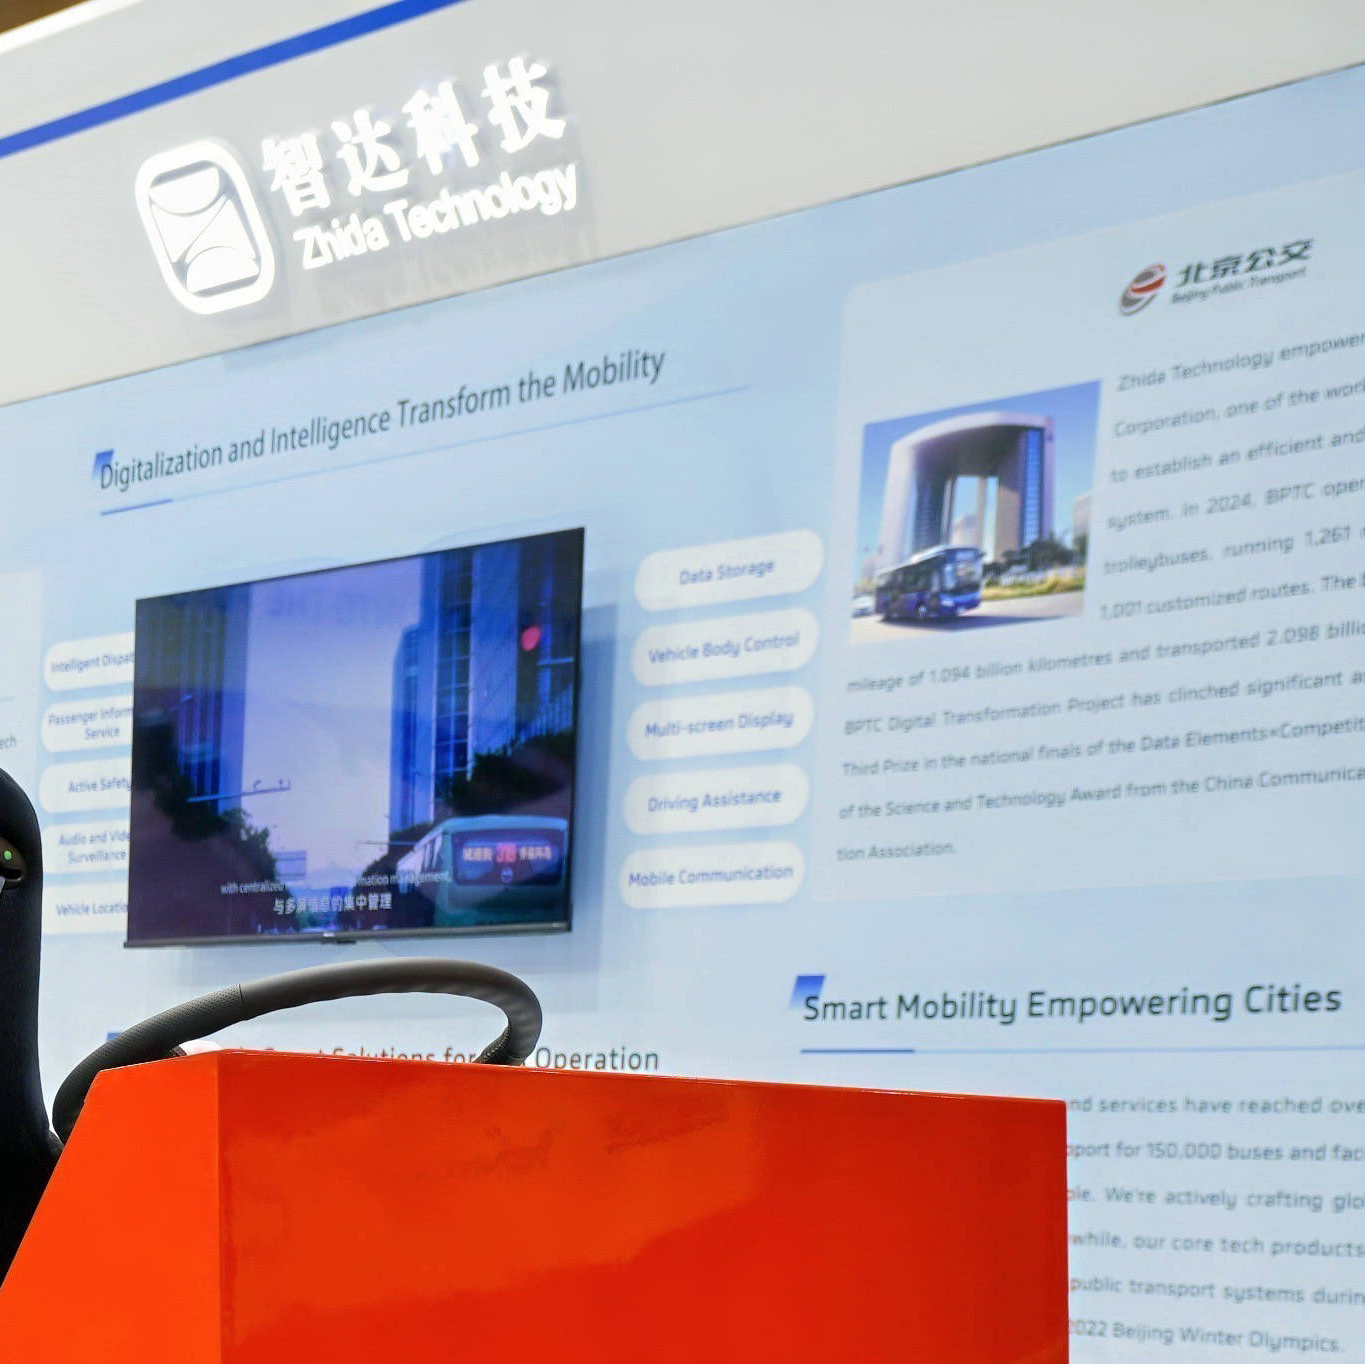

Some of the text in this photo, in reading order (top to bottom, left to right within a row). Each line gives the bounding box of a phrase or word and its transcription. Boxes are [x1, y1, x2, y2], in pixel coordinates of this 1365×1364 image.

[262, 56, 567, 216] 智达科技
[294, 163, 577, 271] Zhida Technology
[1175, 238, 1314, 288] 北京公交
[1118, 370, 1165, 391] Zhida
[1171, 350, 1274, 381] Technology
[1226, 401, 1259, 418] one
[1263, 394, 1284, 410] of
[1287, 388, 1319, 406] the
[99, 348, 666, 491] Digitalization and Intelligence Transform the Mobility
[1110, 468, 1127, 482] to
[1135, 452, 1212, 478] establish
[1217, 450, 1240, 466] an
[1247, 434, 1324, 460] efficient
[1264, 482, 1314, 506] BPTC
[1223, 535, 1294, 556] running
[680, 560, 776, 585] Data Storage
[1146, 587, 1248, 616] customized
[1321, 574, 1357, 592] The
[648, 631, 800, 664] Vehicle Body Control
[50, 652, 101, 674] Intelligent
[846, 674, 903, 692] mileage
[908, 669, 924, 686] of
[975, 659, 1023, 680] billion
[1027, 651, 1113, 674] kilometres
[1119, 645, 1151, 664] and
[1156, 631, 1262, 660] transported
[844, 670, 1345, 735] BPTC Digital Transformation Project has clinched significant
[48, 708, 98, 727] Passenger
[645, 711, 795, 737] Multi-screen Display
[84, 726, 121, 741] Service
[842, 733, 1180, 777] Third Prize in the national finals of the Data
[68, 778, 131, 794] Active Safety
[838, 805, 856, 820] of
[857, 803, 882, 818] the
[885, 799, 941, 817] Science
[943, 795, 971, 812] and
[976, 791, 1066, 809] Technology
[1070, 782, 1121, 801] Award
[1125, 780, 1167, 798] from
[1170, 778, 1200, 795] the
[1204, 773, 1254, 792] China
[648, 789, 782, 813] Driving Assistance
[59, 833, 86, 847] Audio
[88, 830, 108, 845] and
[67, 848, 127, 865] Surveillance
[837, 846, 865, 862] tion
[628, 865, 794, 887] Mobile Communication
[56, 902, 88, 917] Vehicle
[803, 984, 1342, 1025] Smart Mobility Empowering Cities
[535, 1046, 660, 1073] Operation
[1098, 1098, 1177, 1114] services
[1183, 1097, 1231, 1114] have
[1239, 1096, 1322, 1114] reached
[1116, 1142, 1141, 1157] for
[1227, 1143, 1283, 1160] buses
[1288, 1144, 1326, 1161] and
[1104, 1187, 1156, 1203] We're
[1165, 1189, 1237, 1211] actively
[1246, 1190, 1323, 1213] crafting
[1133, 1235, 1165, 1250] our
[1172, 1235, 1215, 1252] core
[1220, 1235, 1264, 1255] tech
[1070, 1275, 1121, 1293] public
[1128, 1278, 1215, 1300] transport
[1222, 1284, 1304, 1304] systems
[1112, 1322, 1345, 1354] Beijing Winter Olympics.
